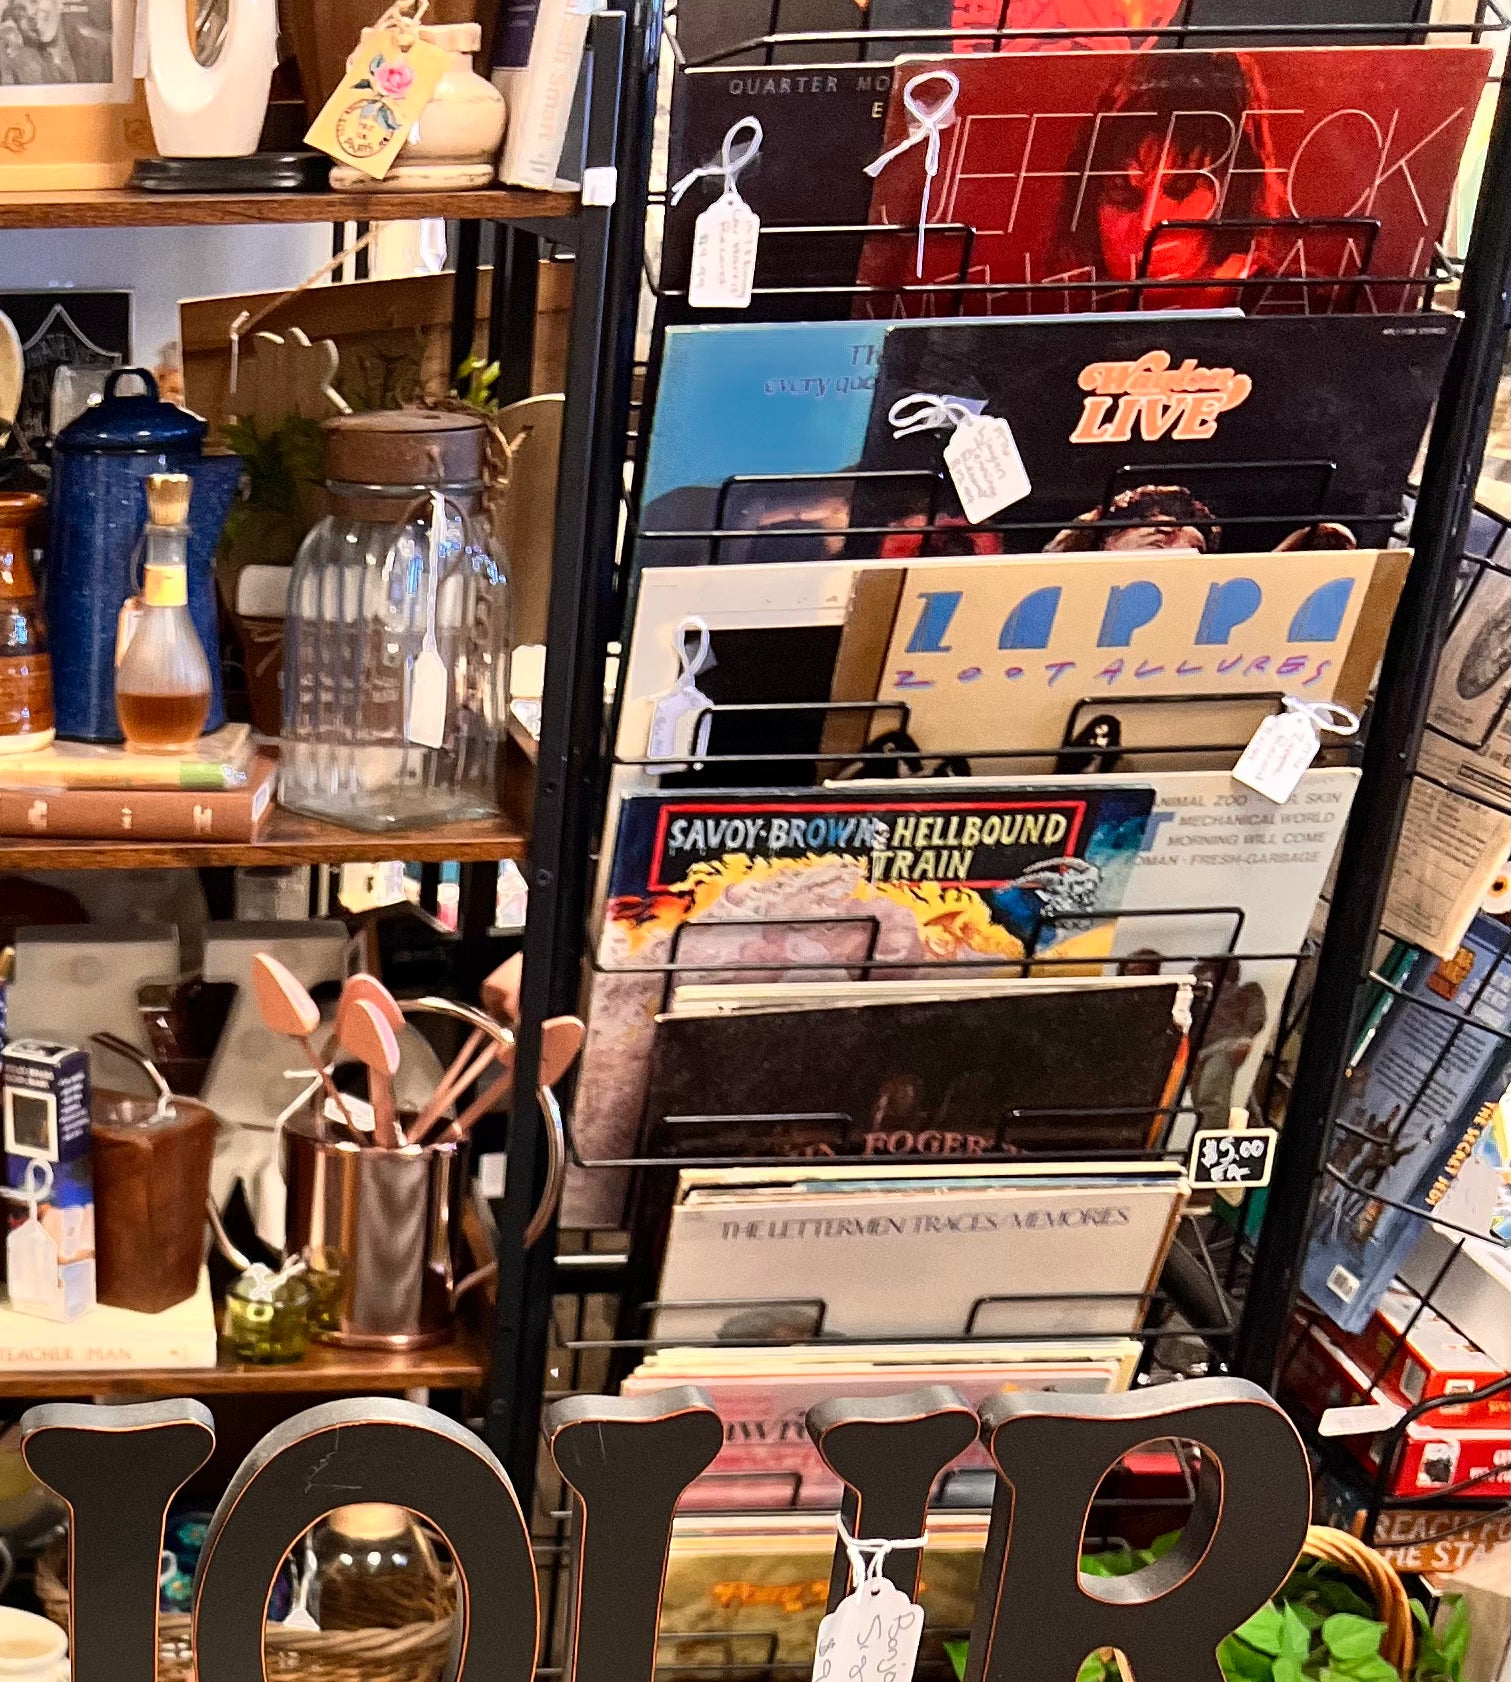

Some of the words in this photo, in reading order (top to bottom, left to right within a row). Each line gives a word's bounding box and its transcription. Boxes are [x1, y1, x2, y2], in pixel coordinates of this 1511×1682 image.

[728, 76, 839, 96] QUARTER
[1068, 394, 1227, 444] LIVE
[904, 576, 1356, 654] ZAPPA
[892, 660, 1077, 689] ZOOT
[1094, 654, 1332, 686] ALLURES
[1155, 796, 1203, 807] NIMAL
[1179, 814, 1275, 826] MECHANICAL
[1280, 811, 1335, 824] WORLD
[892, 812, 1067, 850] HELLBOUND
[1168, 834, 1238, 847] MORNING
[1243, 833, 1276, 845] WILL
[1282, 831, 1327, 844] COME
[870, 848, 974, 882] TRAIN
[1134, 854, 1177, 866] OMAN
[1200, 1136, 1265, 1169] $5.00
[720, 1219, 765, 1241] THE
[87, 1346, 133, 1362] MAN
